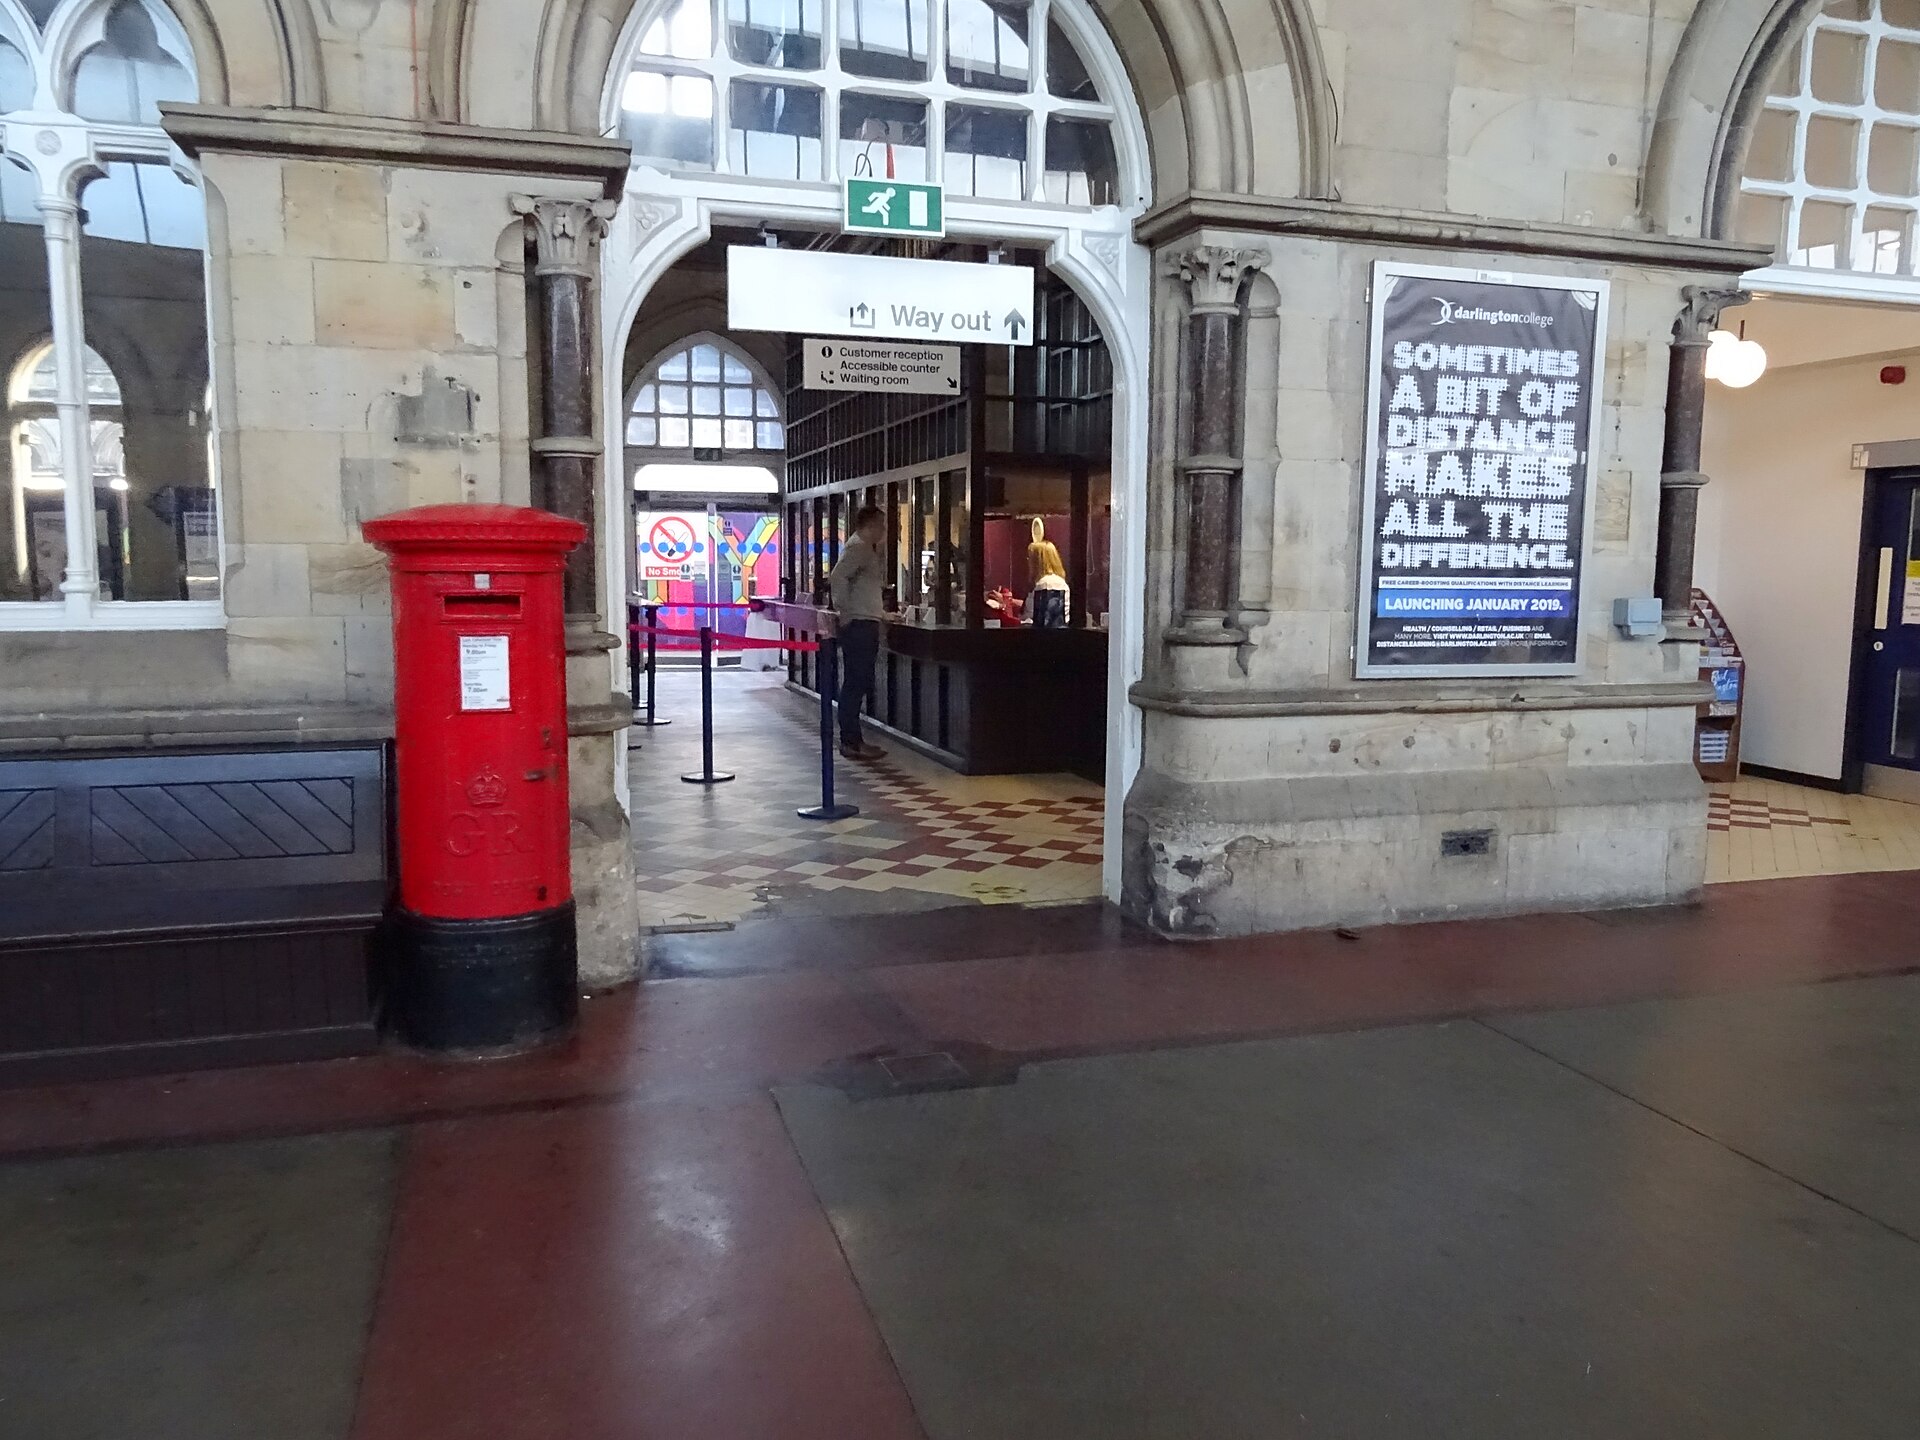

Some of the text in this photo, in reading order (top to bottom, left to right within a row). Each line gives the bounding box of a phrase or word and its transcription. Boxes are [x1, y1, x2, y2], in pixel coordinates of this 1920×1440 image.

[890, 304, 992, 333] Way out
[1454, 305, 1554, 328] darlingtoncollege
[839, 347, 944, 361] Customer reception
[840, 360, 941, 374] Accessible counter
[1393, 341, 1580, 377] SOMETIMES
[840, 373, 909, 385] Waiting room
[1388, 373, 1581, 418] A BIT OF
[1387, 414, 1576, 451] DISTANCE
[1384, 451, 1575, 499] MAKES
[1380, 498, 1569, 541] ALL THE
[1380, 541, 1575, 570] DIFFERENCE.
[648, 567, 661, 576] No
[1384, 597, 1564, 611] LAUNCHING JANUARY 2019.
[447, 811, 535, 858] GR
